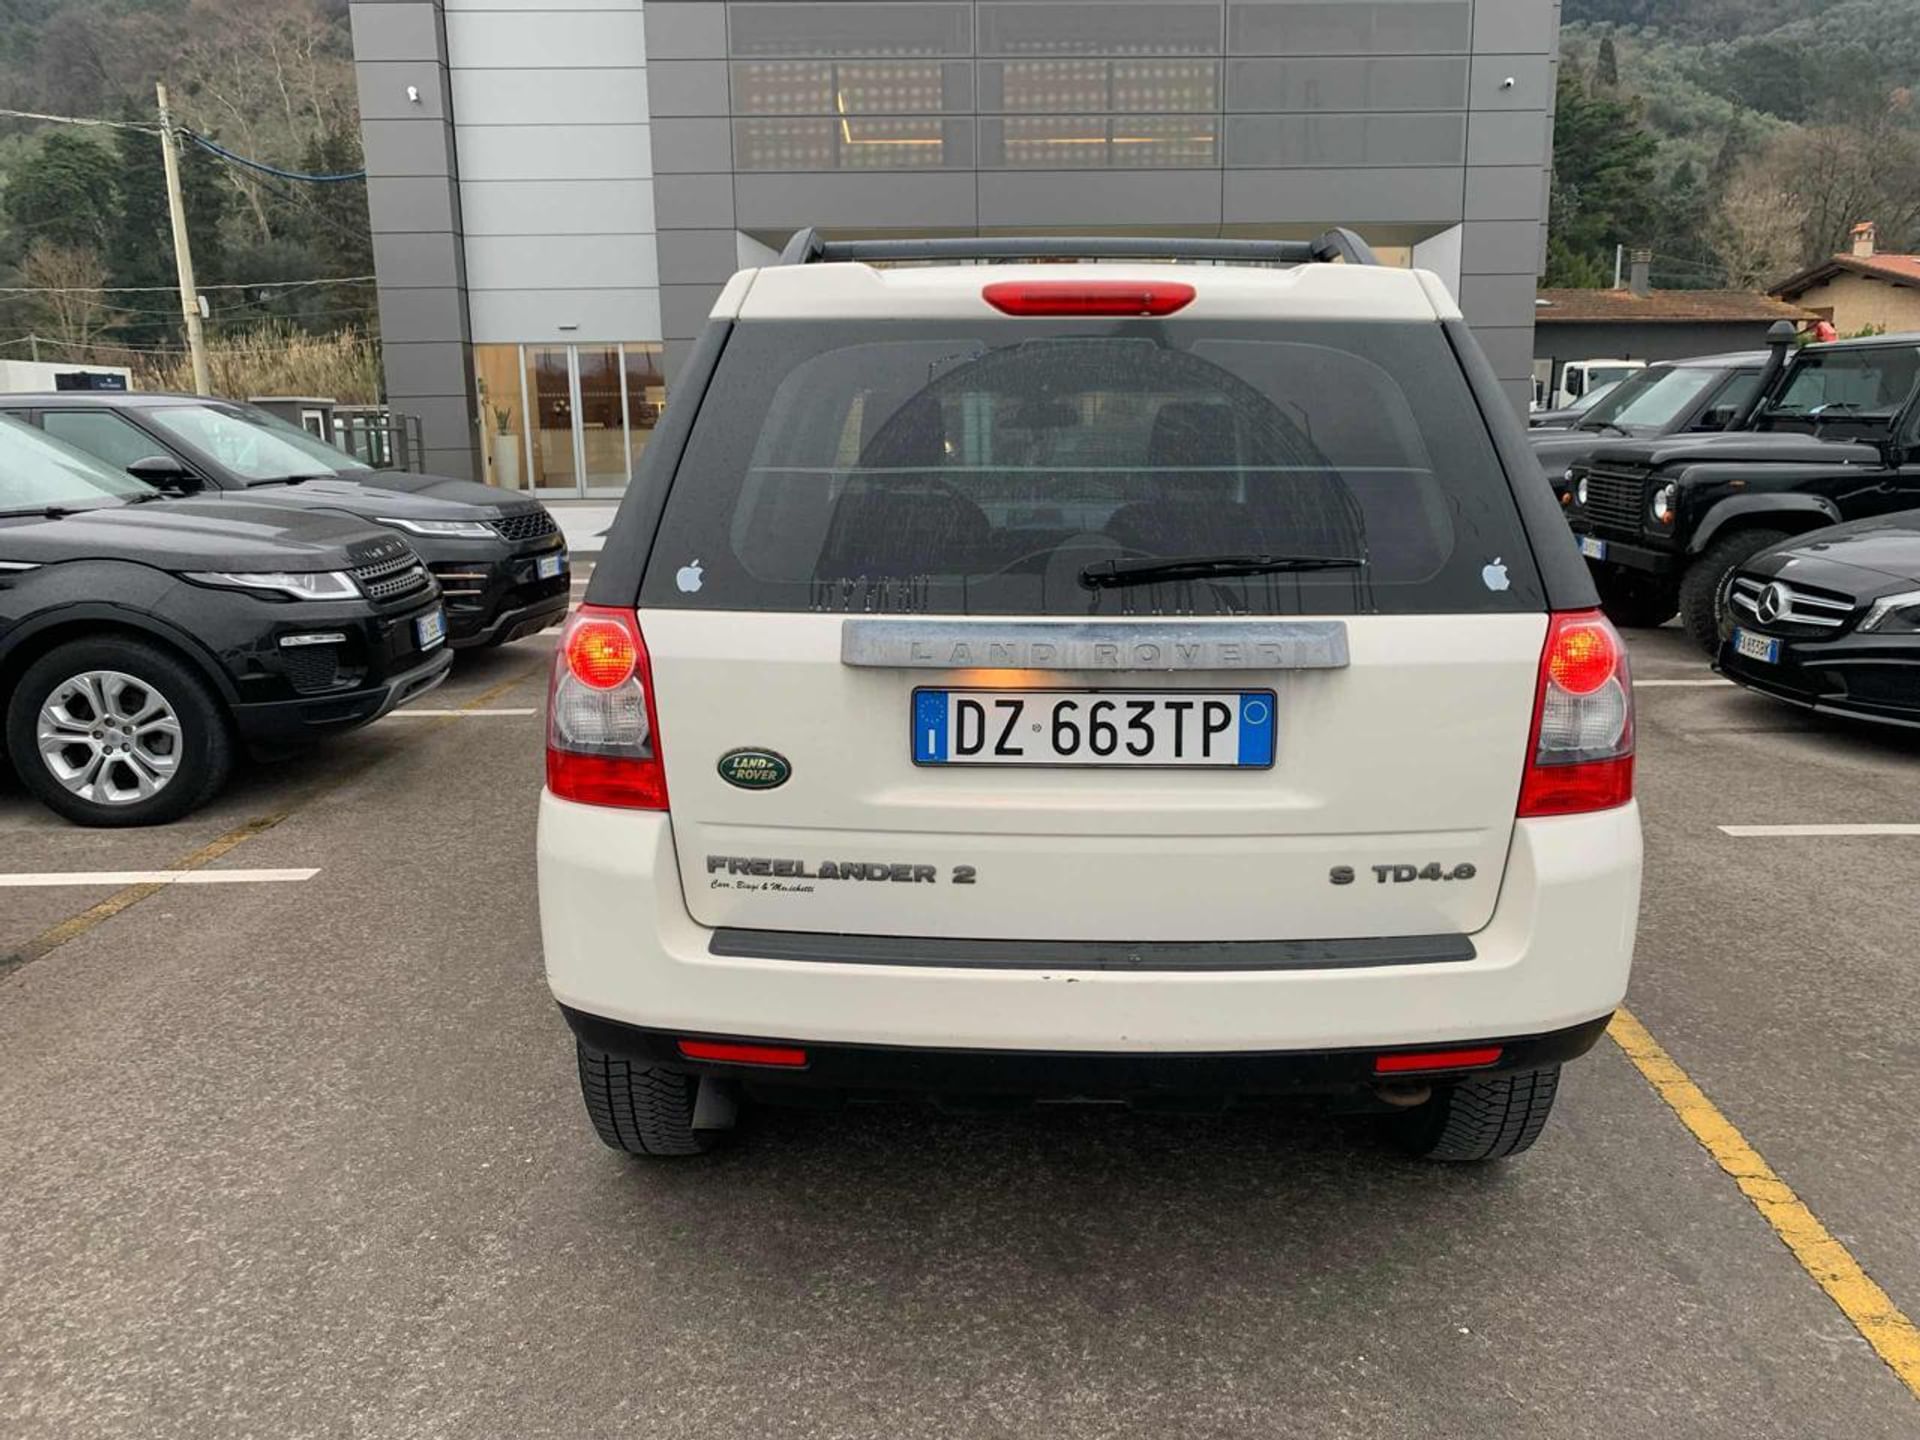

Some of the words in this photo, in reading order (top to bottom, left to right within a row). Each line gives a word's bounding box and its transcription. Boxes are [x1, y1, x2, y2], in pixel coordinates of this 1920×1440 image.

[910, 641, 1057, 665] LAND
[1093, 642, 1283, 666] ROVER
[954, 699, 1025, 757] DZ
[1051, 700, 1232, 758] 663TP
[733, 757, 767, 768] LAND
[736, 769, 777, 780] ROVER
[706, 855, 937, 883] FREELANDER
[952, 865, 977, 884] 2
[1329, 865, 1355, 885] S
